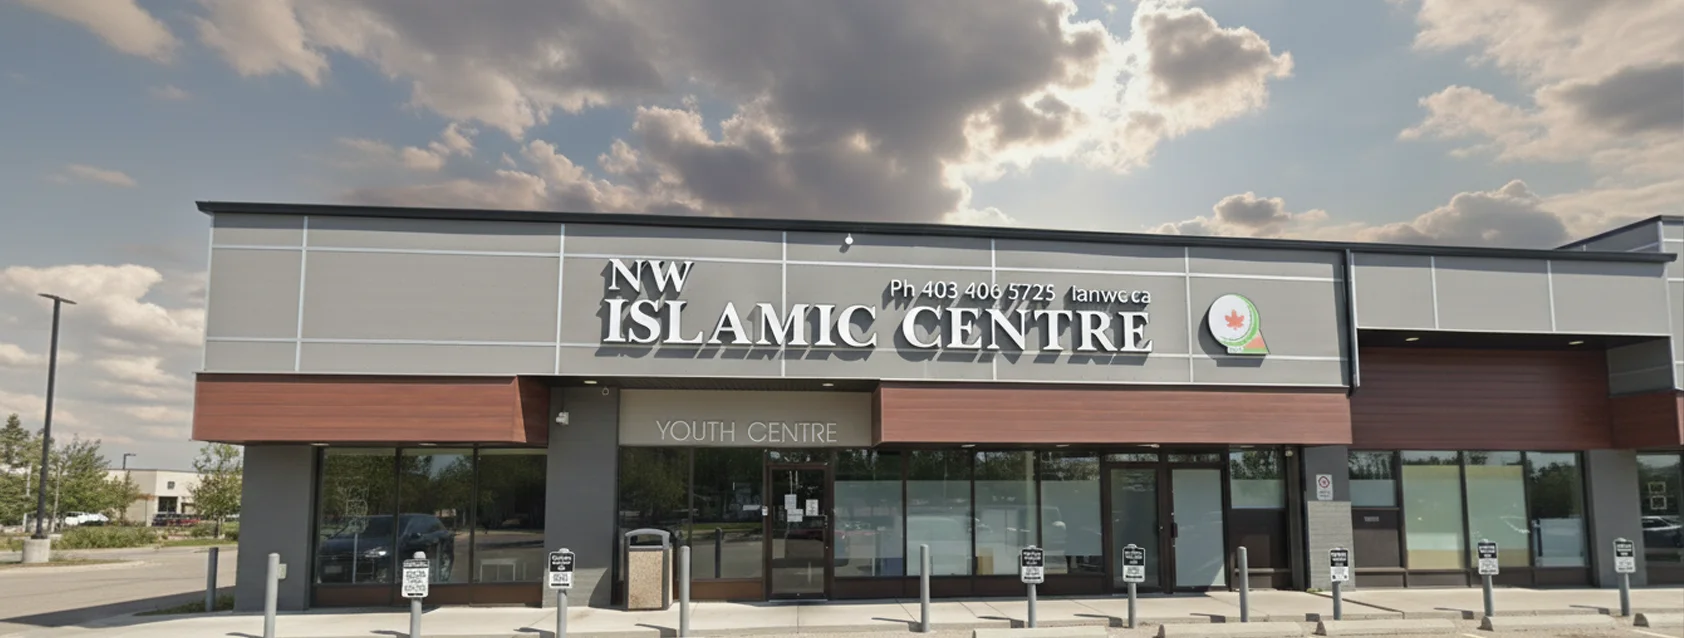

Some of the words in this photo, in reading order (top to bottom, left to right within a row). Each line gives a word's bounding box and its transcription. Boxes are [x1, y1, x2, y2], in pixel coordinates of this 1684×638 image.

[608, 258, 694, 293] NW
[890, 279, 915, 298] Ph
[922, 280, 958, 299] 403
[964, 281, 1002, 300] 406
[1008, 283, 1056, 301] 5725
[603, 298, 877, 348] ISLAMIC
[902, 305, 1153, 352] CENTRE
[656, 420, 736, 442] YOUTH
[747, 421, 837, 443] CENTRE
